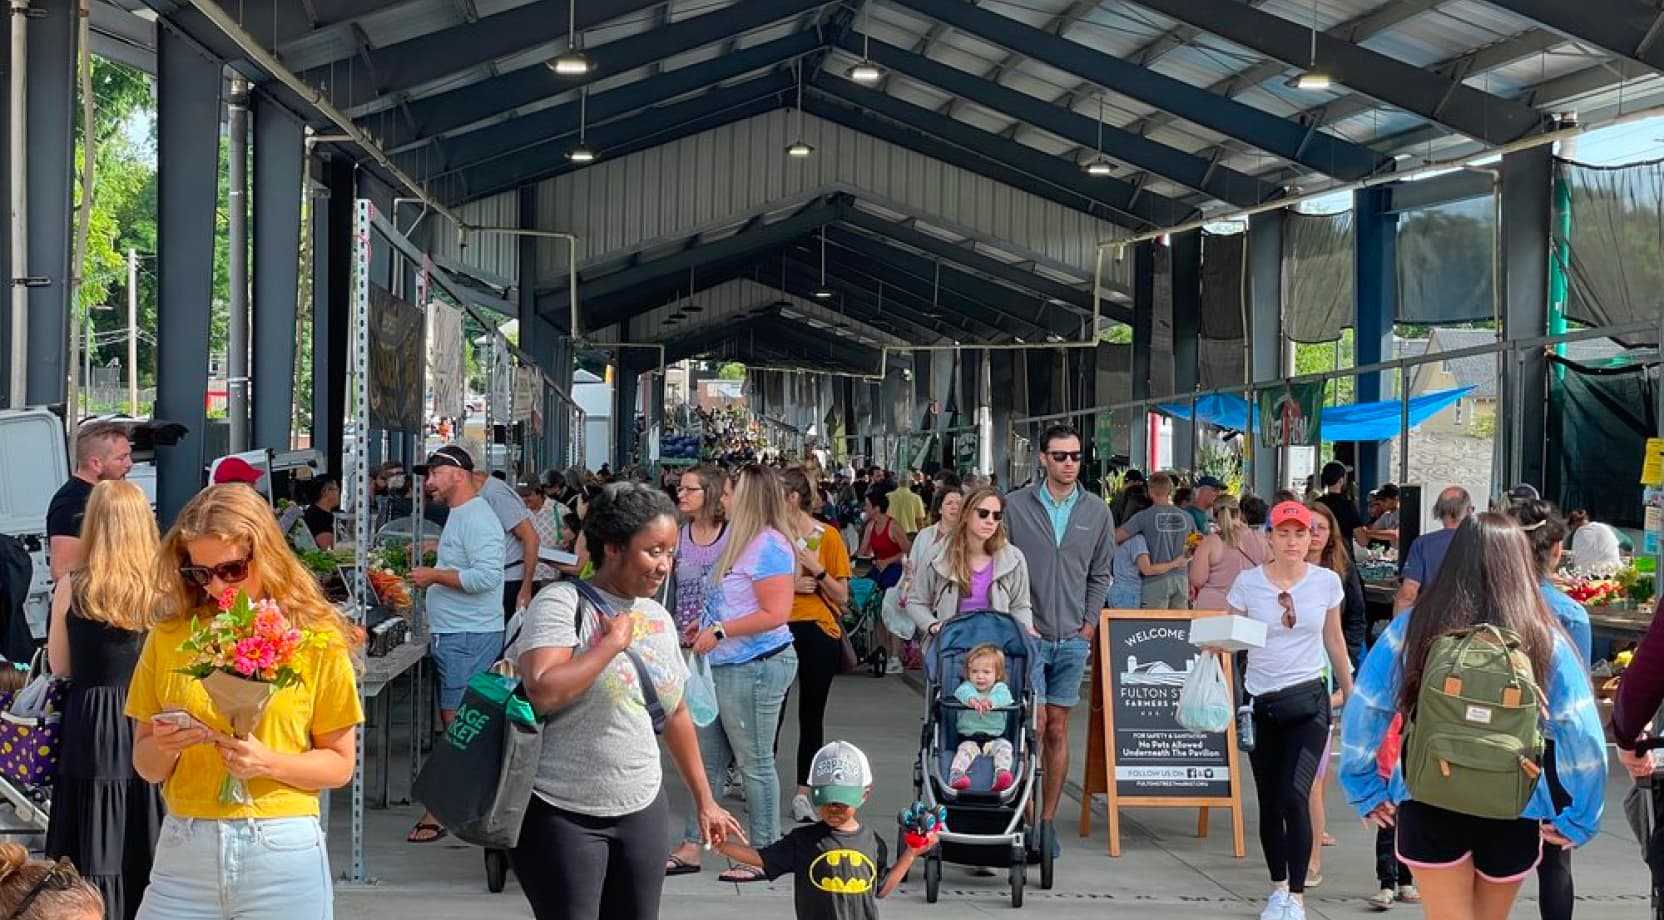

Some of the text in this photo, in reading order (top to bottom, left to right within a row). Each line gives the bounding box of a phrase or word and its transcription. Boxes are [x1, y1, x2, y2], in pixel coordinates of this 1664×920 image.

[1124, 628, 1185, 646] WELCOME
[1120, 687, 1167, 698] FULTON
[1125, 699, 1168, 707] FARMERS
[455, 703, 490, 730] AGE
[448, 719, 480, 744] KET
[1138, 740, 1203, 749] No Pets Allowed
[1122, 748, 1220, 757] Underneath The Pavilion
[1128, 769, 1160, 777] FOLLOW
[1172, 769, 1184, 777] ON
